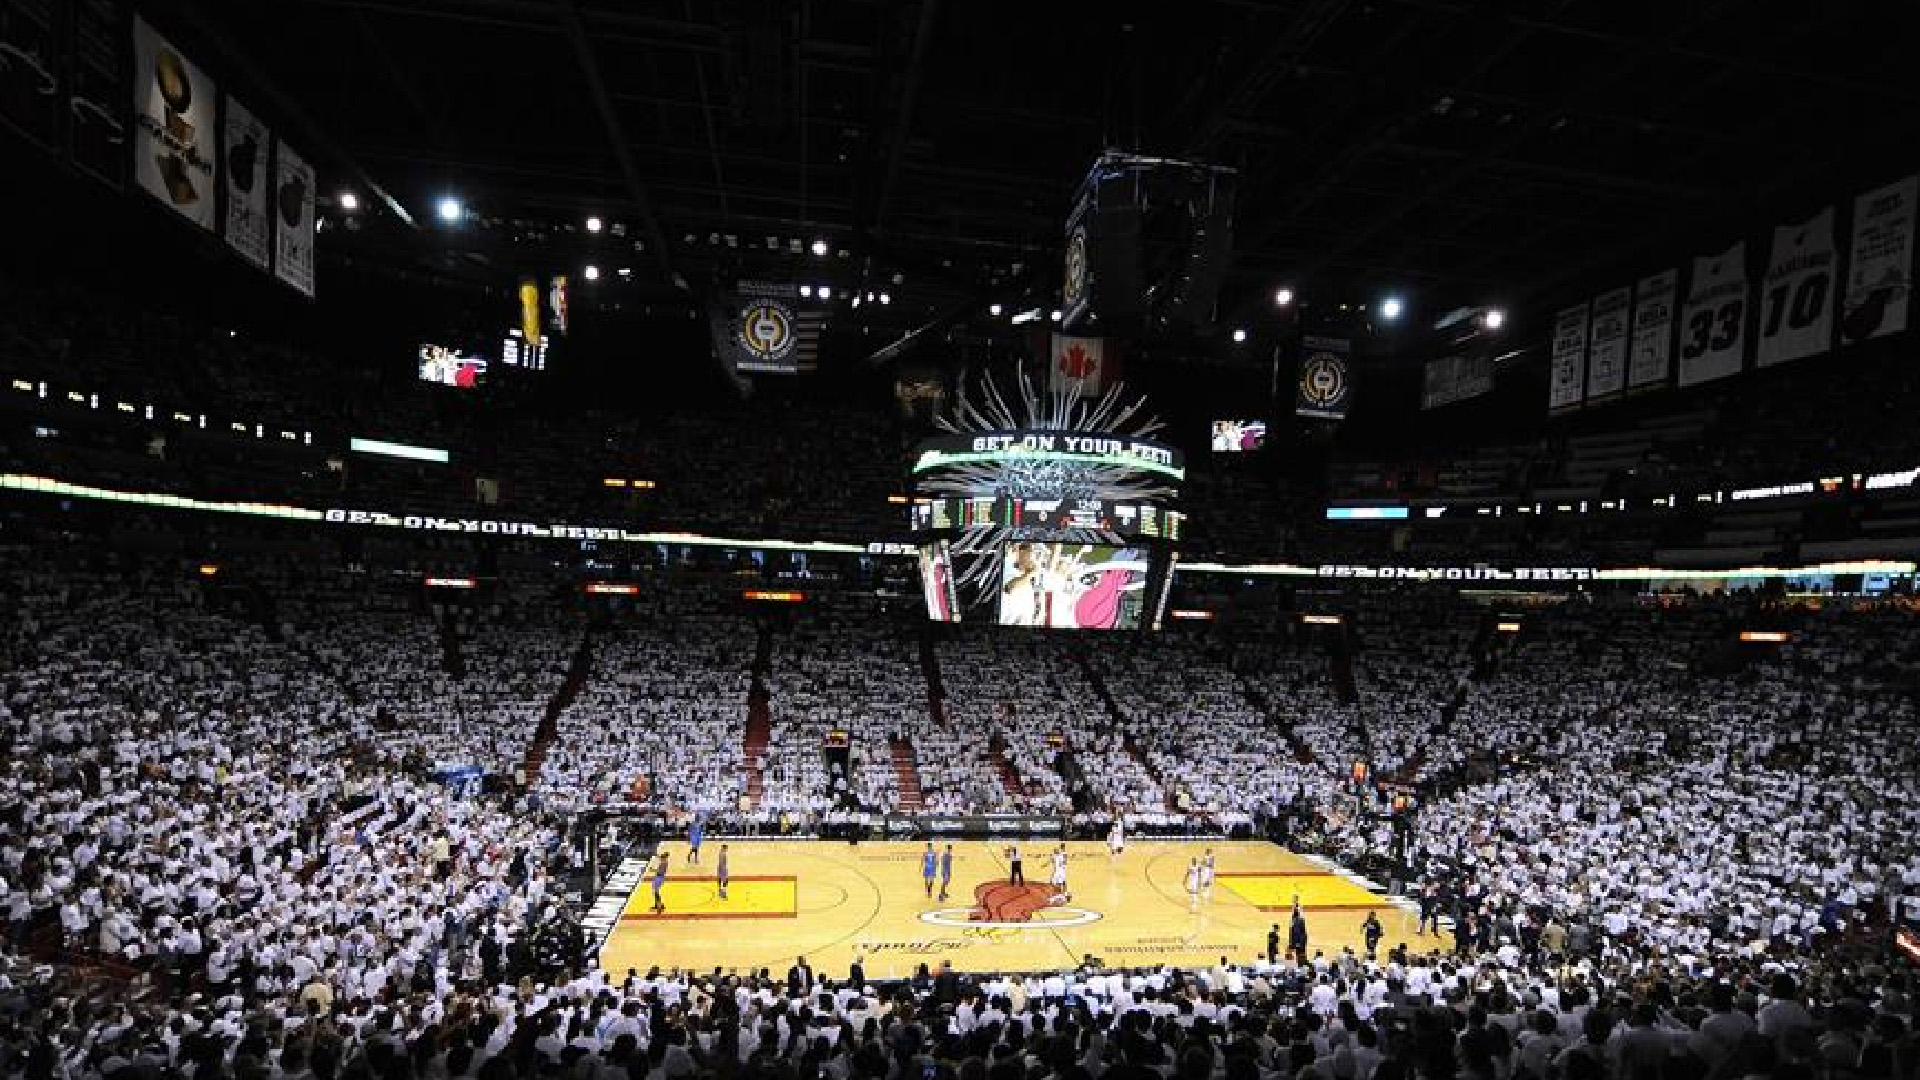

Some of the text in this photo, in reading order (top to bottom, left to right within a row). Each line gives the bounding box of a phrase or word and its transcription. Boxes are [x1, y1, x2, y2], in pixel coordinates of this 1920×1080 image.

[1765, 273, 1829, 338] 10
[1683, 300, 1742, 359] 33
[973, 436, 1015, 452] GET
[1023, 436, 1055, 453] ON
[1064, 437, 1122, 455] YOUR
[325, 508, 390, 525] GET
[404, 515, 445, 530] ON
[460, 518, 536, 535] YOUR
[1319, 563, 1369, 578] GET
[1379, 565, 1414, 579] ON
[1427, 567, 1500, 580] YOUR
